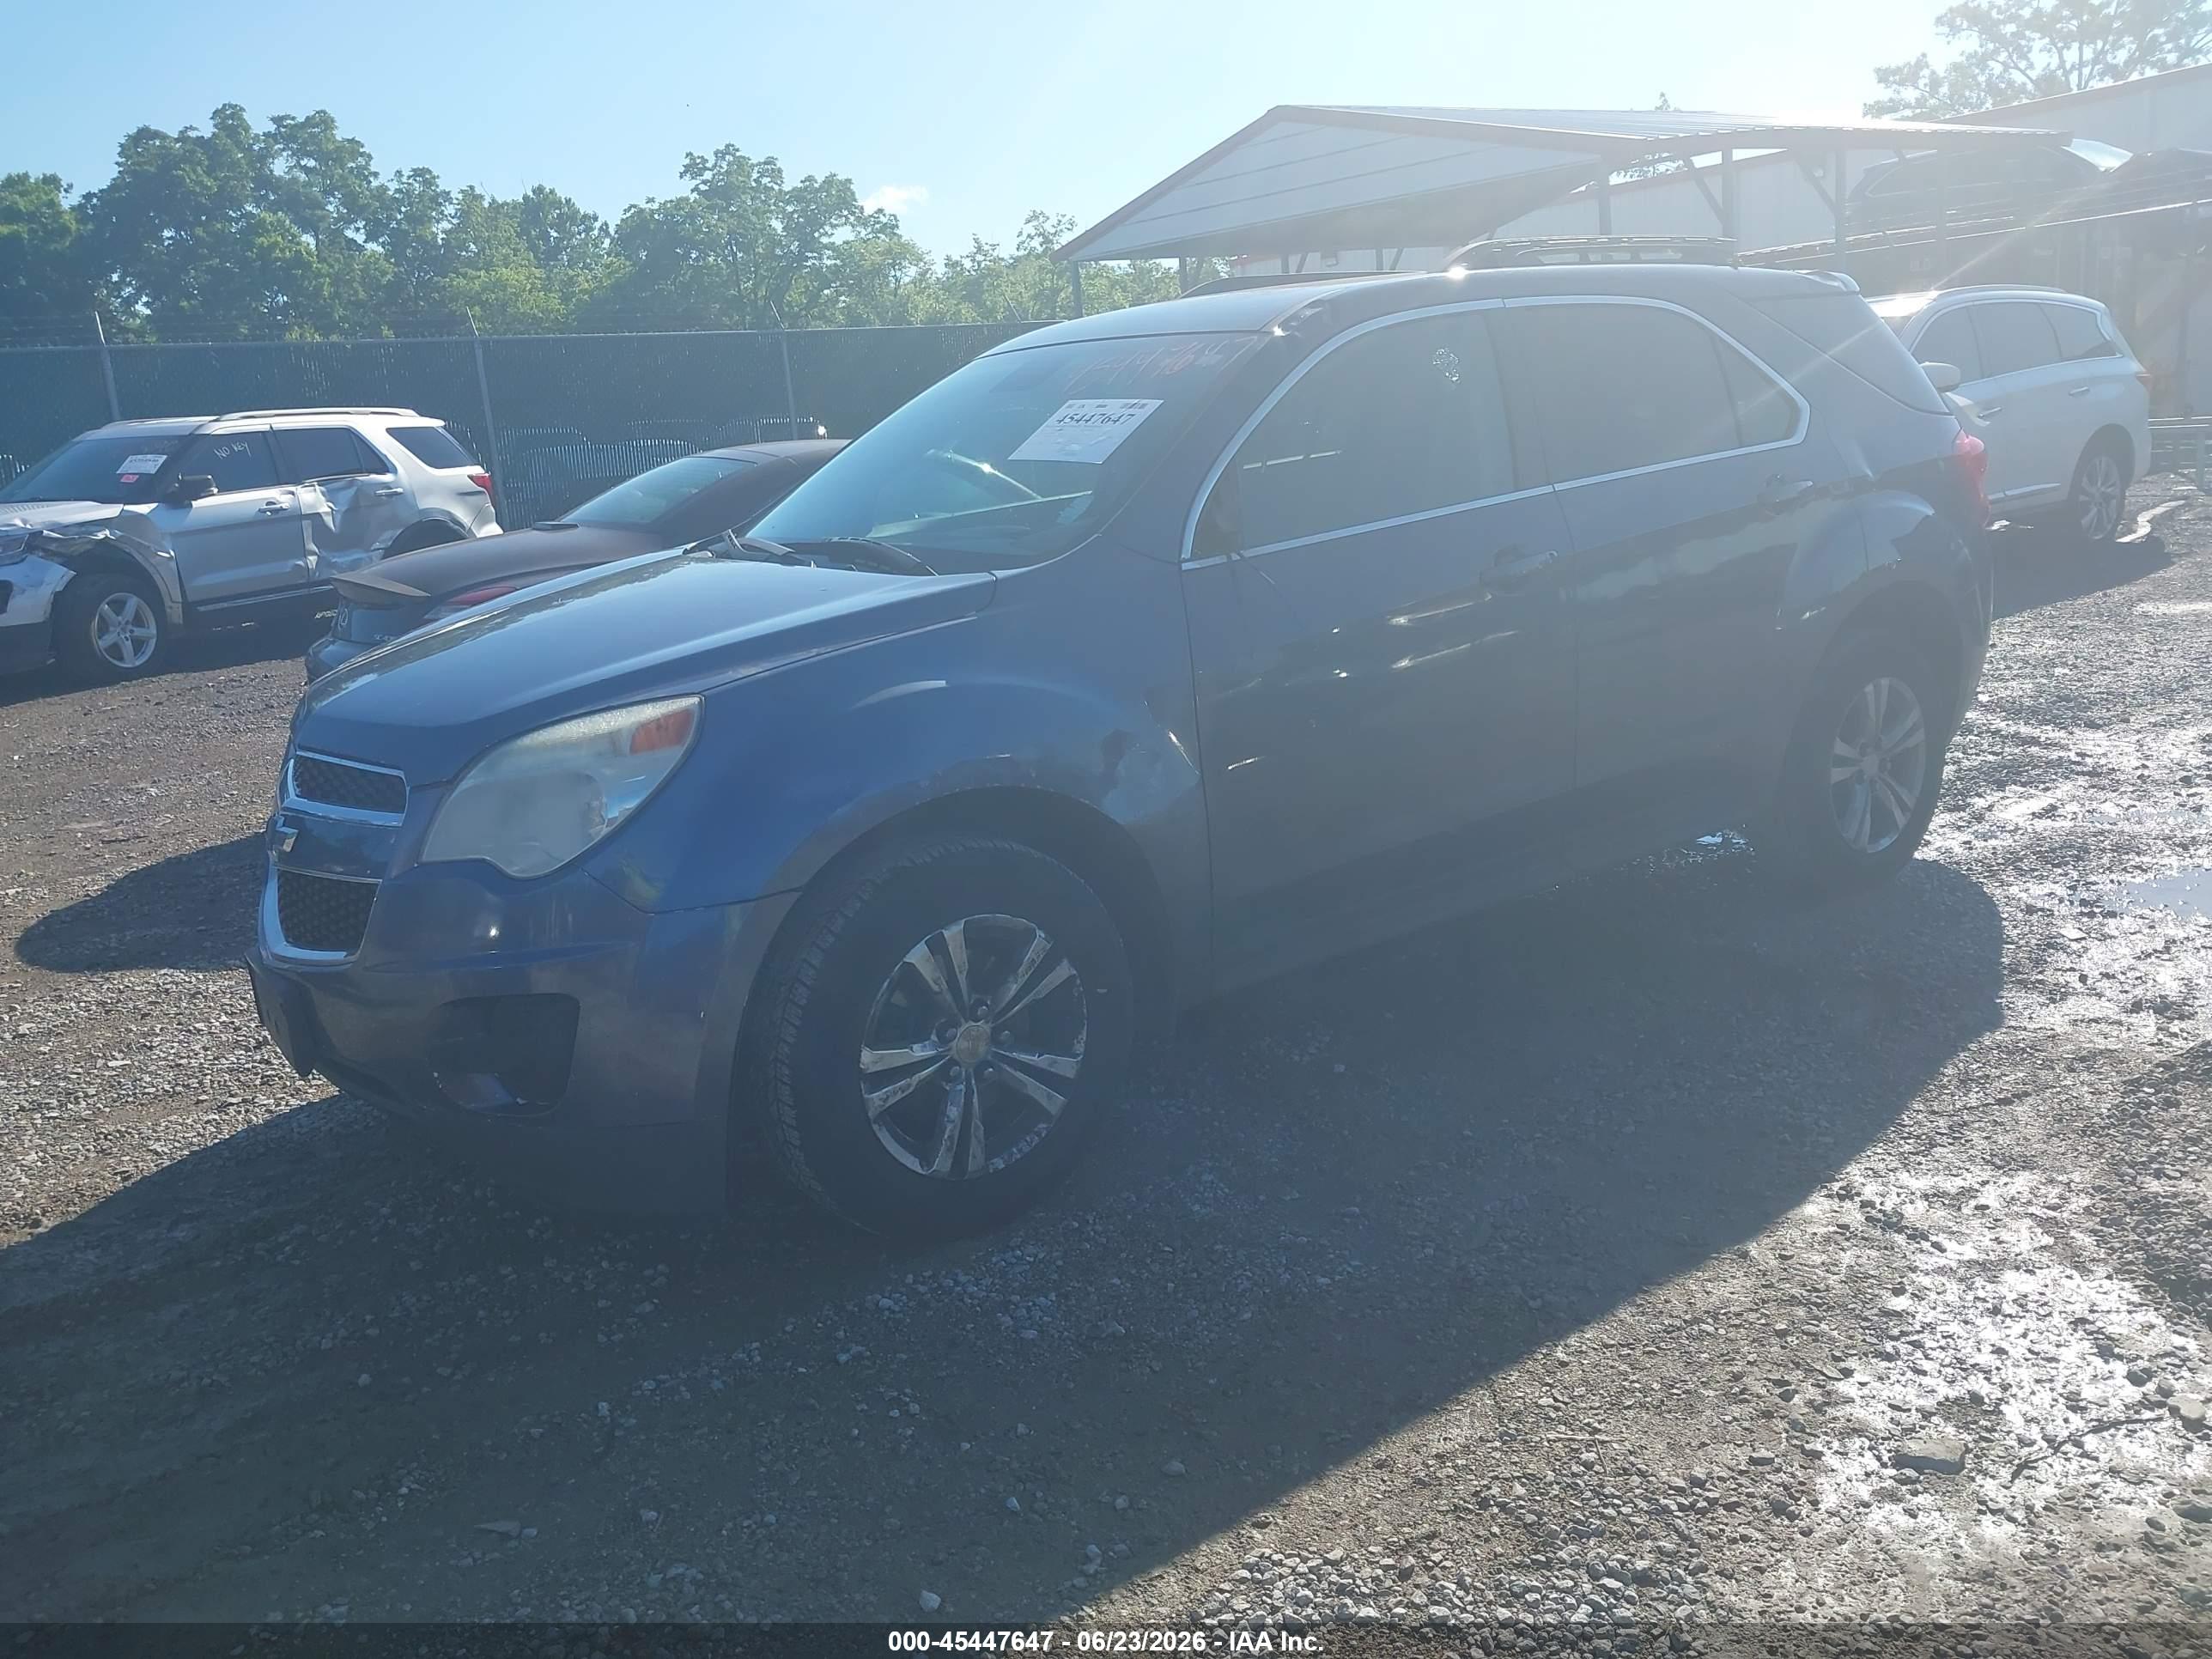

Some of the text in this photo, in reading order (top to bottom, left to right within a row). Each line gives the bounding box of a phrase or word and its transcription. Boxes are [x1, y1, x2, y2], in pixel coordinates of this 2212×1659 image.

[1056, 413, 1136, 425] 45447647
[214, 441, 252, 459] NO KEY
